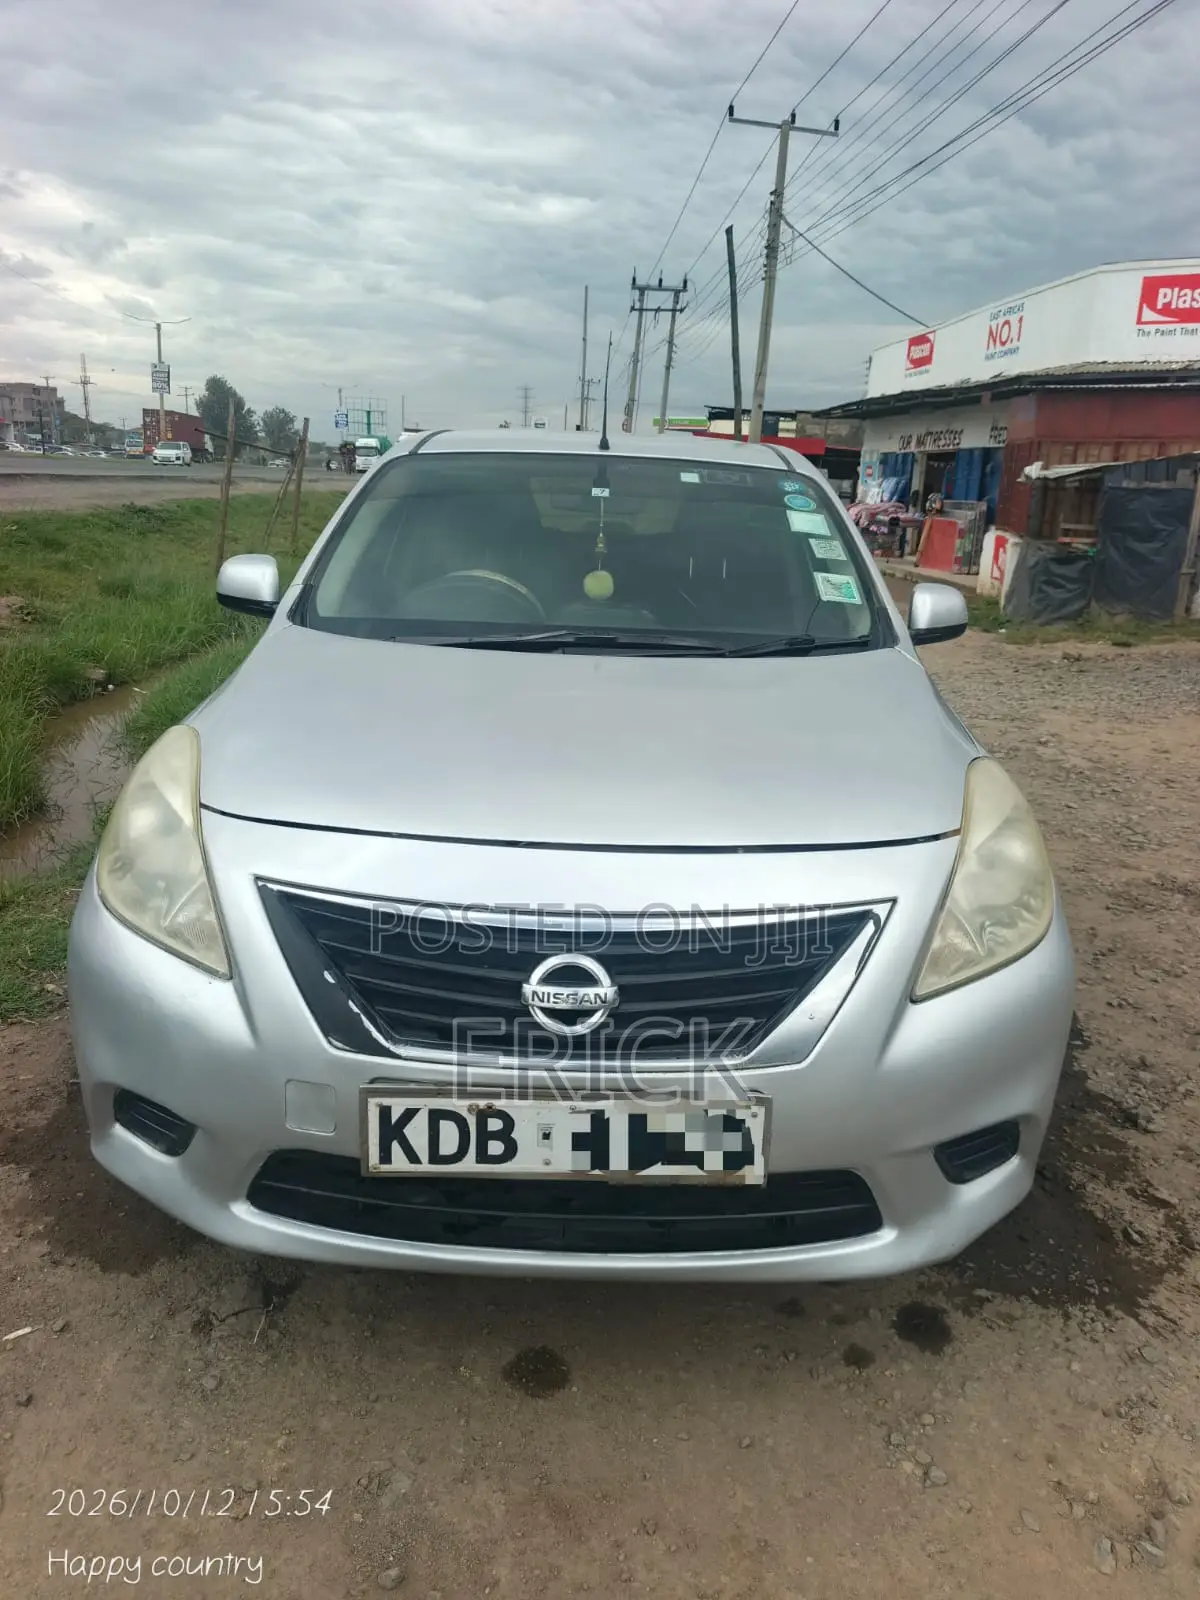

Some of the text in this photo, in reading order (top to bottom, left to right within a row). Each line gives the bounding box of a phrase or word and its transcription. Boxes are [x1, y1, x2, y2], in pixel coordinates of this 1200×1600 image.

[1156, 287, 1200, 309] Plas
[986, 315, 1024, 352] NO.1
[1136, 327, 1199, 337] The Paint That
[531, 990, 608, 1005] NISSAN
[378, 1105, 519, 1165] KDB
